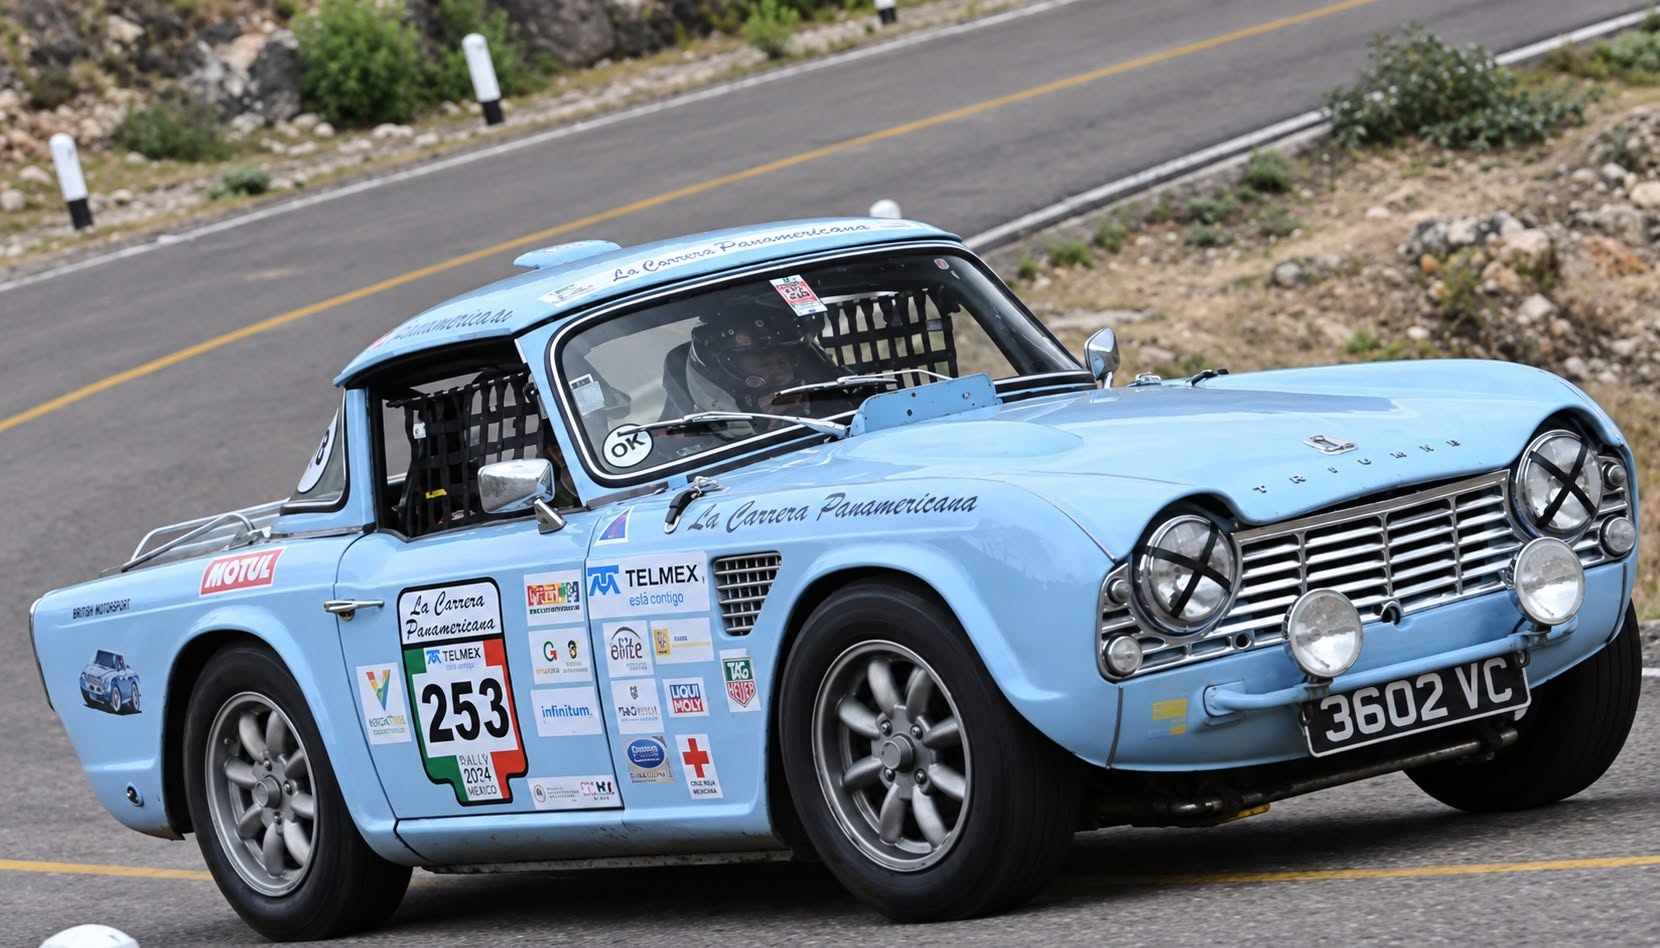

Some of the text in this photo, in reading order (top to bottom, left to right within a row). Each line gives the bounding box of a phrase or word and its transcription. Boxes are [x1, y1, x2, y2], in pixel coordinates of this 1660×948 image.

[613, 269, 639, 282] La
[715, 224, 870, 253] Panamericana
[611, 432, 646, 458] OK
[688, 492, 978, 533] La Carrera Panamericana
[204, 554, 274, 588] MOTUL
[625, 564, 698, 588] TELMEX
[410, 591, 485, 616] La Carrera
[650, 592, 684, 606] contigo
[405, 618, 496, 640] Panamericana
[442, 647, 481, 662] TELMEX
[727, 661, 749, 680] TAG
[671, 685, 700, 698] LIQUI
[1320, 656, 1512, 742] 3602 VC
[421, 678, 509, 743] 253
[541, 705, 590, 718] infinitum
[674, 698, 703, 713] MOLY
[459, 753, 488, 766] RALLY
